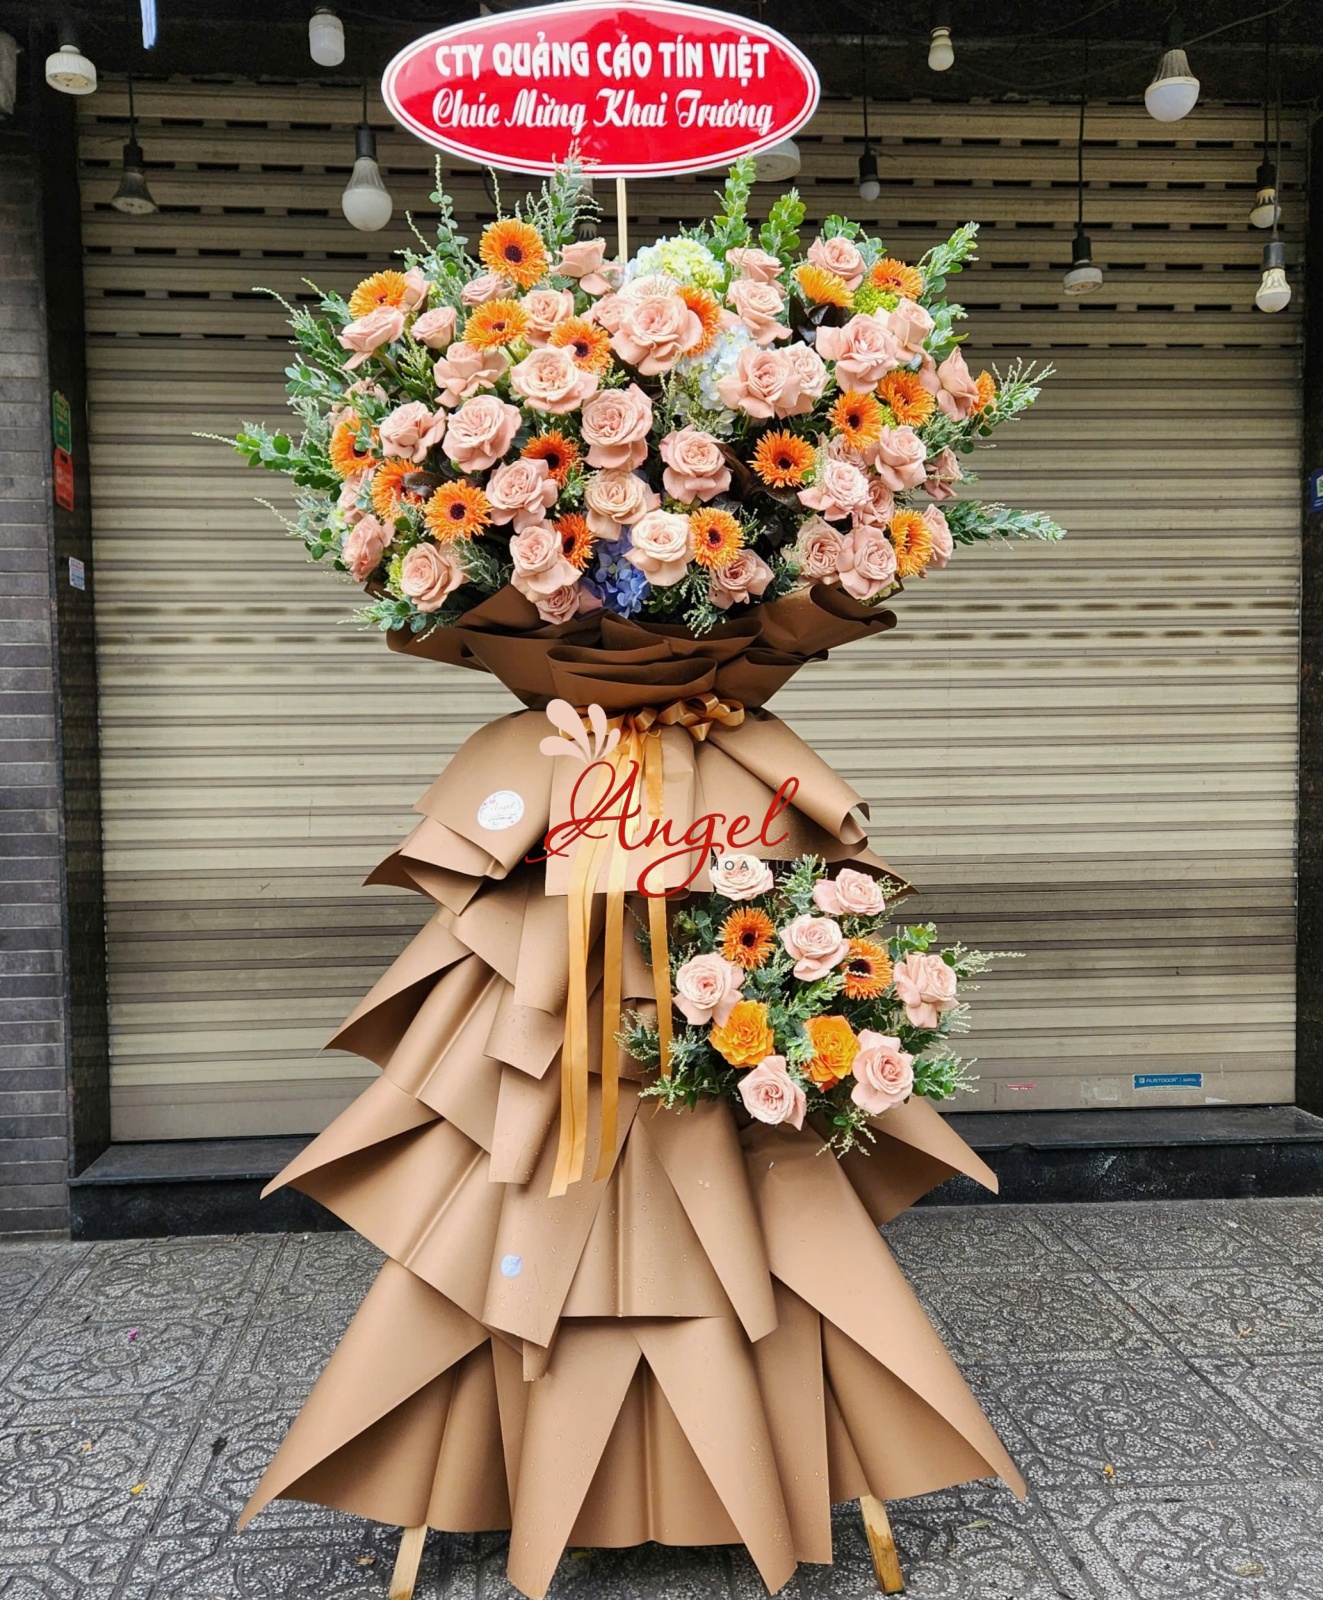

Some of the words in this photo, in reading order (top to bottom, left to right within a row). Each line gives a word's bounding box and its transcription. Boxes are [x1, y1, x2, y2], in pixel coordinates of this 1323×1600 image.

[435, 44, 484, 81] CTY
[492, 31, 590, 81] QUẢNG
[596, 34, 653, 81] CÁO
[658, 34, 704, 78] TÍN
[709, 35, 770, 87] VIỆT
[432, 87, 500, 128] Chúc
[504, 88, 588, 136] Mừng
[593, 88, 668, 127] Khai
